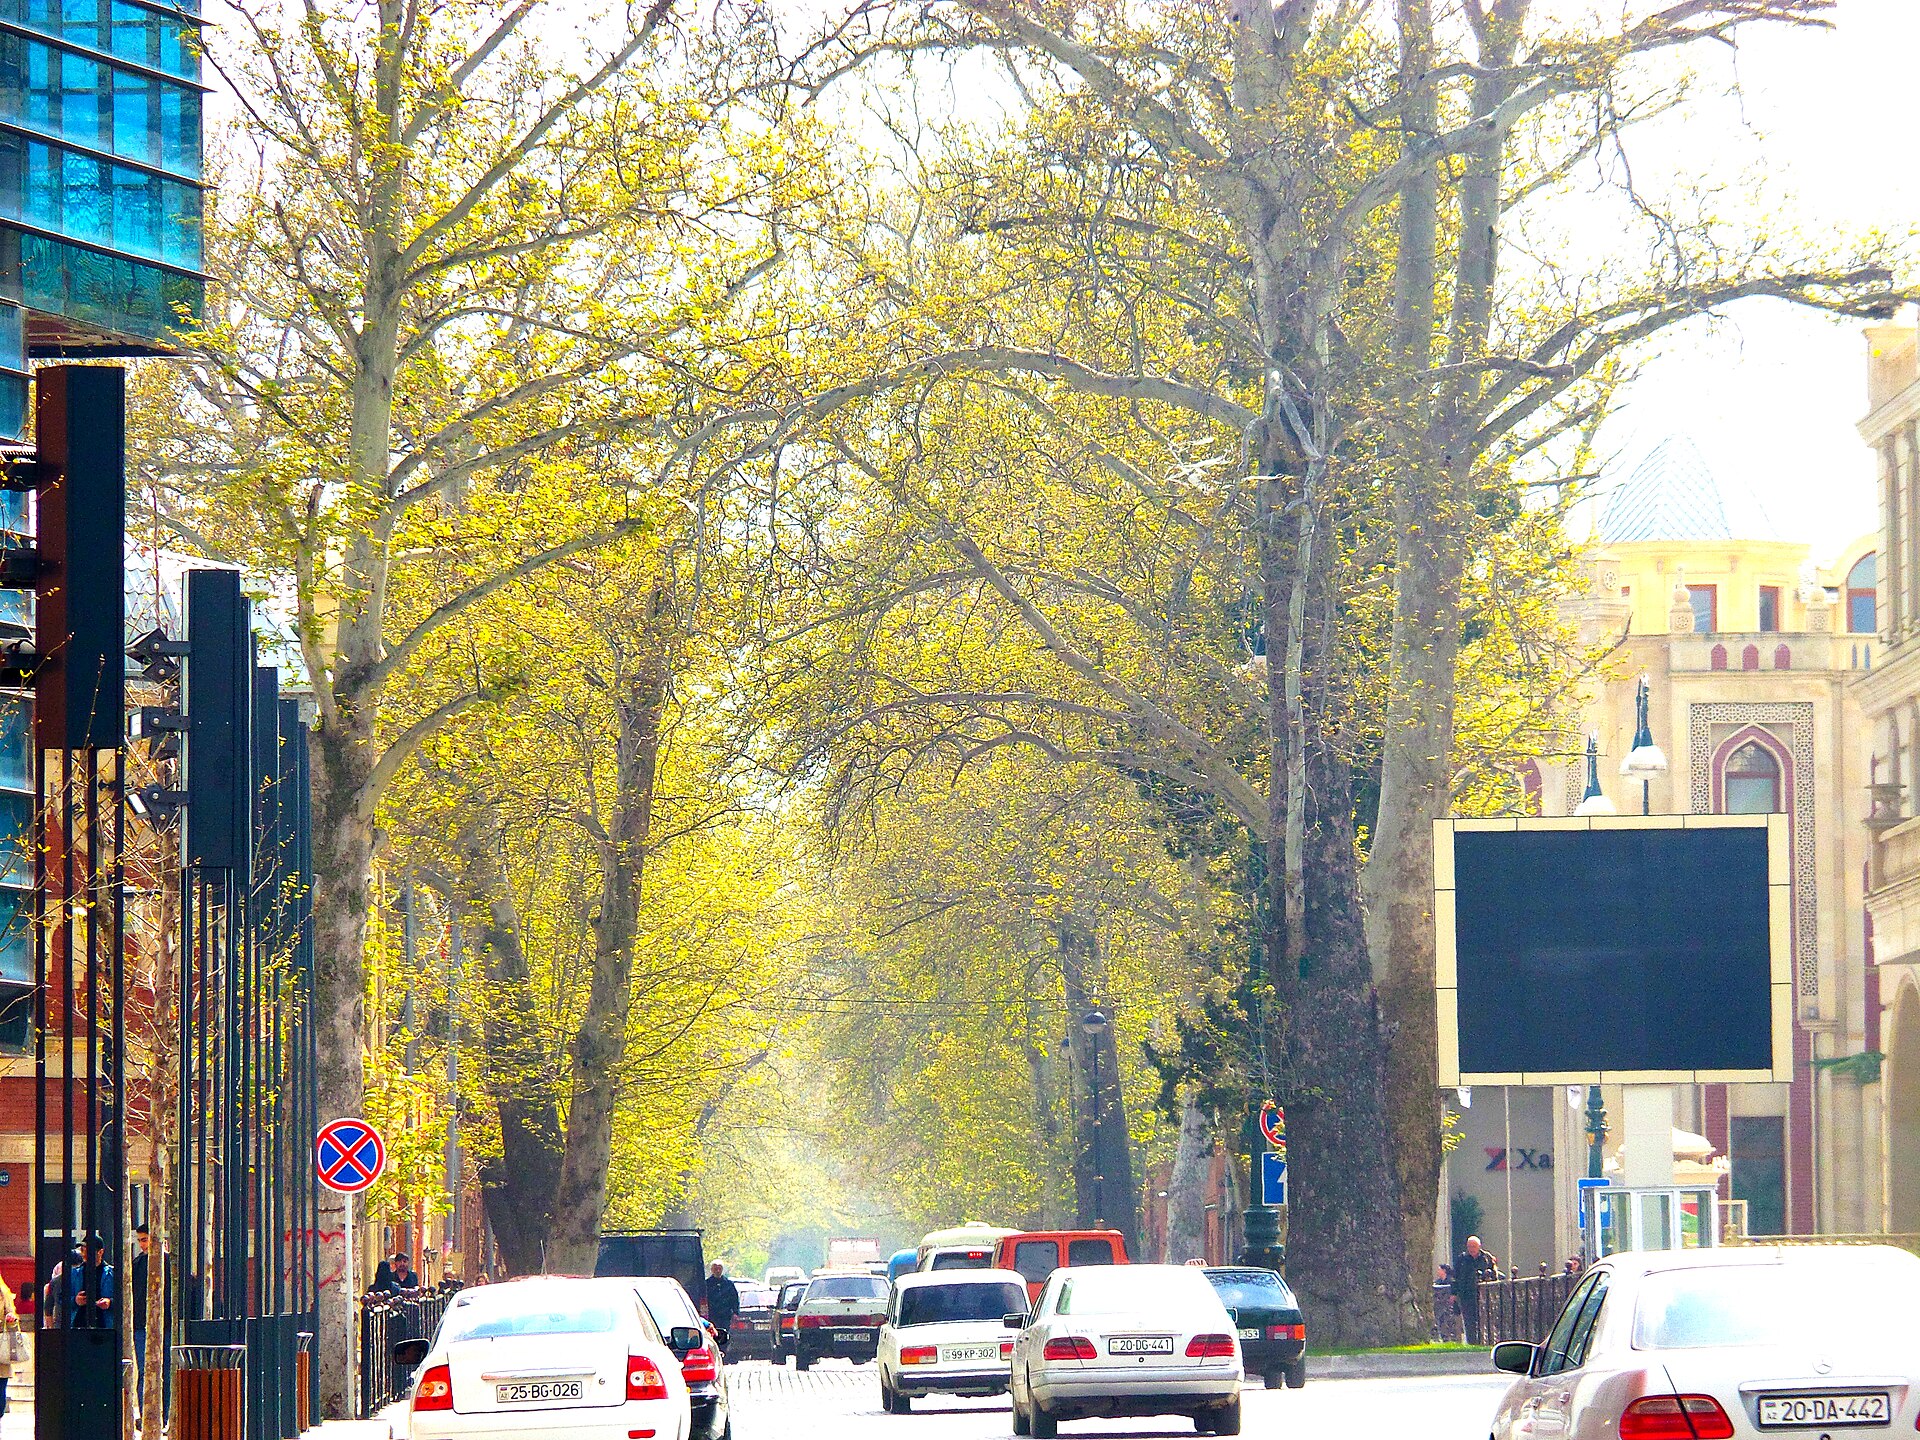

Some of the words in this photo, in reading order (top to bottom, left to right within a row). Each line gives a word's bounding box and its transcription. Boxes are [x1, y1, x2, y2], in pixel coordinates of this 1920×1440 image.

[1120, 1339, 1169, 1351] 20-DG-441
[510, 1383, 579, 1400] 25-BG-026
[1781, 1398, 1884, 1421] 20-DA-442
